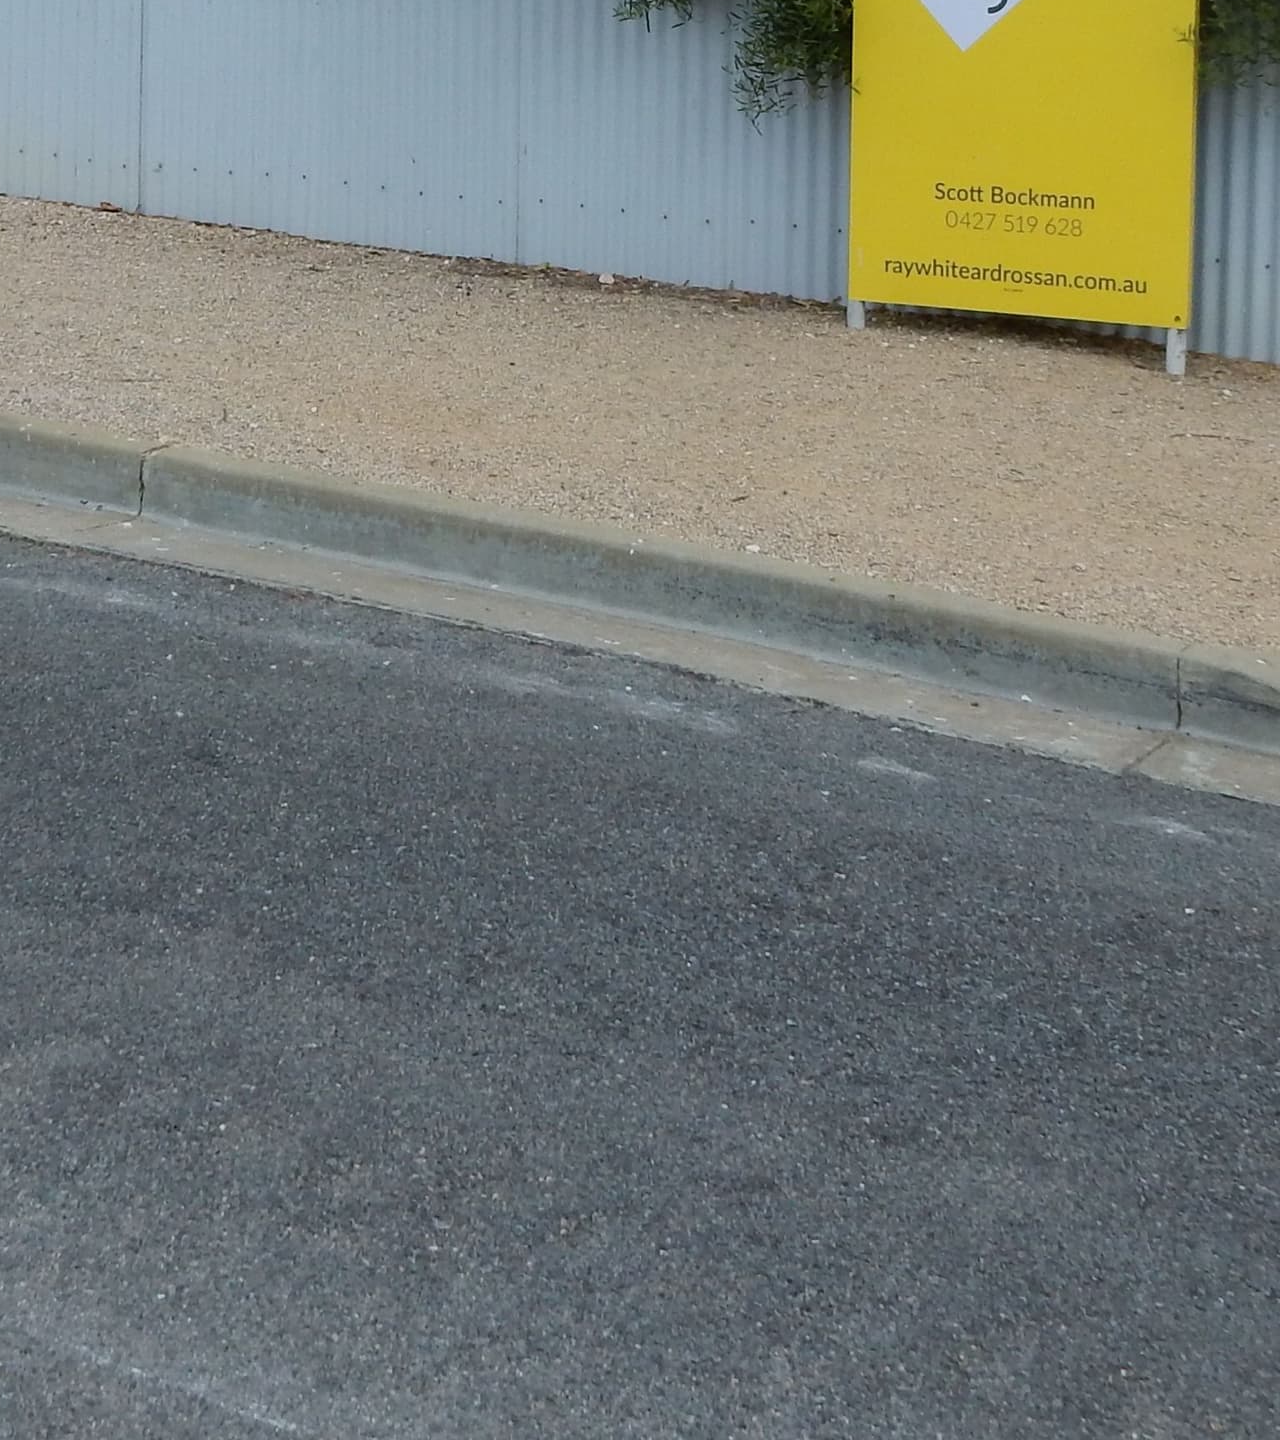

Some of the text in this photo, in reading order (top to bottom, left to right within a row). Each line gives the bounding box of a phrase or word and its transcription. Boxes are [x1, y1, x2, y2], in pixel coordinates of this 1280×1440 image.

[934, 182, 1096, 210] Scott Bockmann
[945, 210, 1083, 237] 0427 519 628
[884, 258, 1148, 294] raywhiteardrossan.com.au
